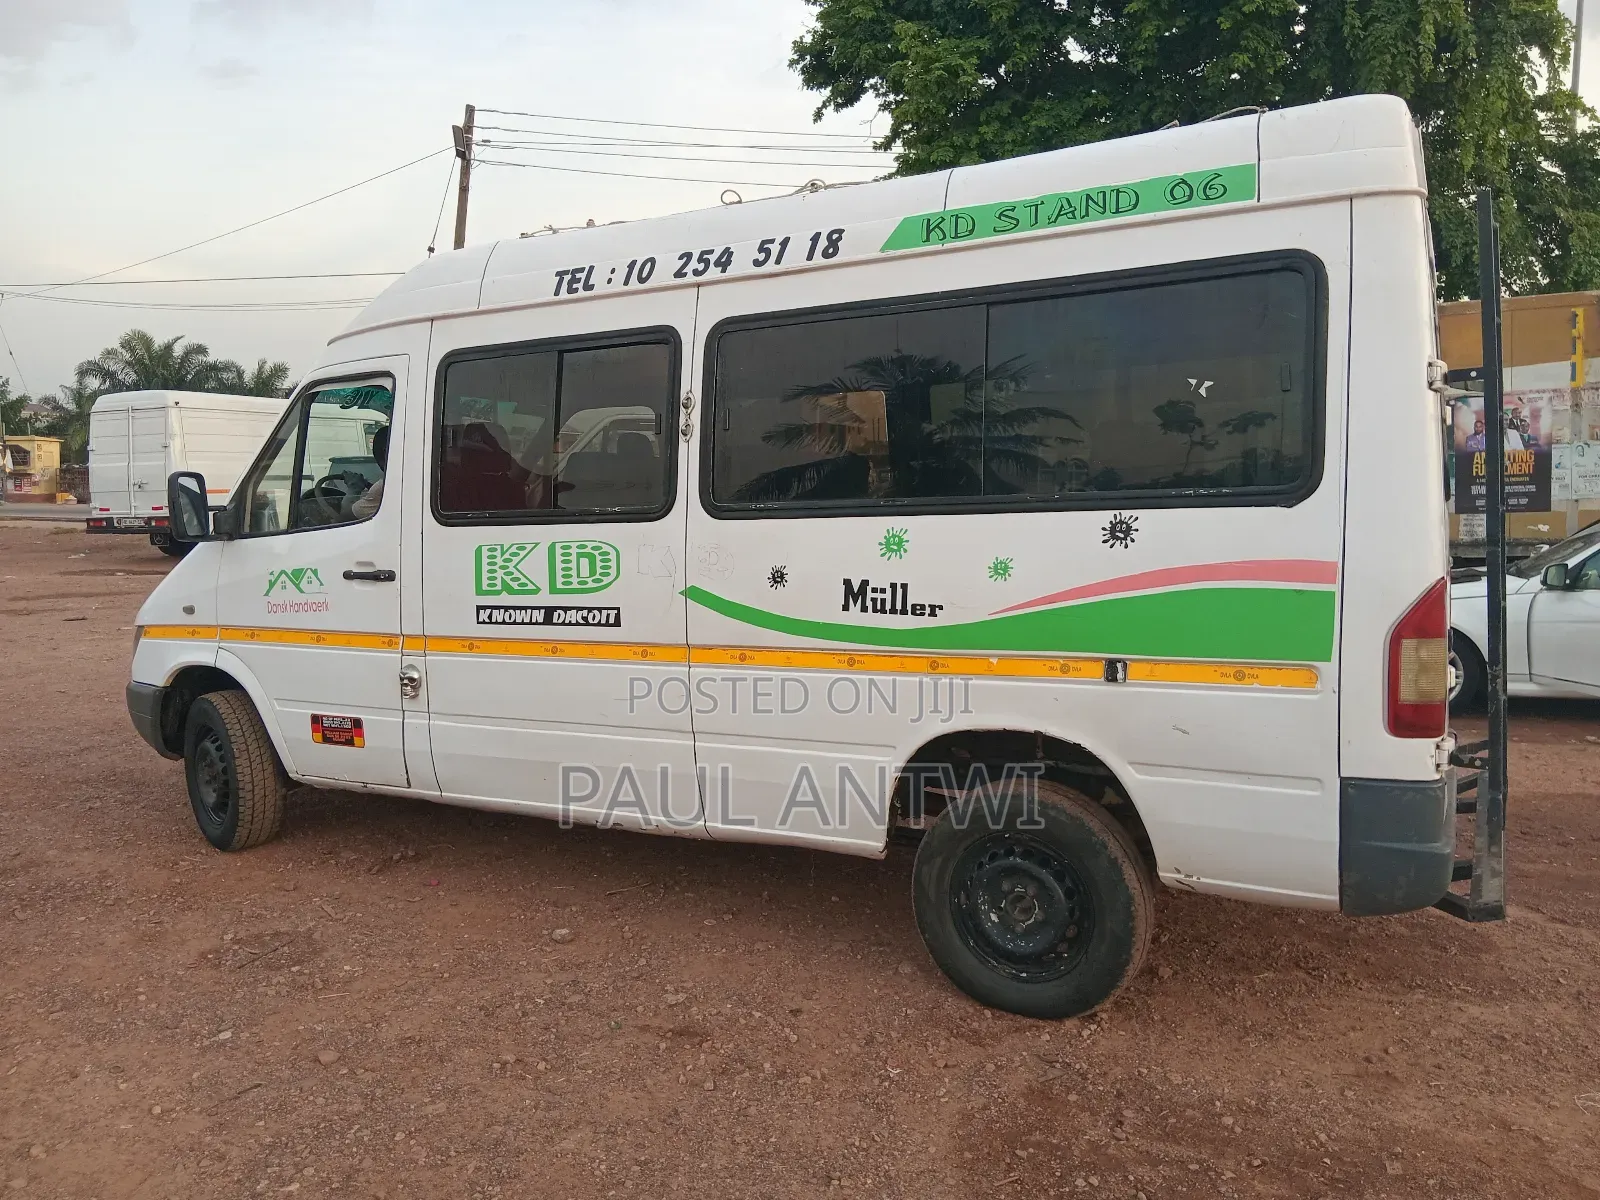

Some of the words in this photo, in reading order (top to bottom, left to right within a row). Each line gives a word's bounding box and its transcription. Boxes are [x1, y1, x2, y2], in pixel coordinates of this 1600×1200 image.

[921, 211, 976, 243] KD
[992, 185, 1140, 234] STAND
[1163, 173, 1228, 206] 06
[673, 246, 735, 279] 254
[752, 236, 791, 268] 51
[805, 228, 846, 262] 18
[266, 600, 289, 615] Dansk
[288, 597, 330, 614] Handvaerk
[478, 607, 545, 624] KNOWN
[552, 608, 618, 625] DACOIT
[841, 577, 944, 618] Müller
